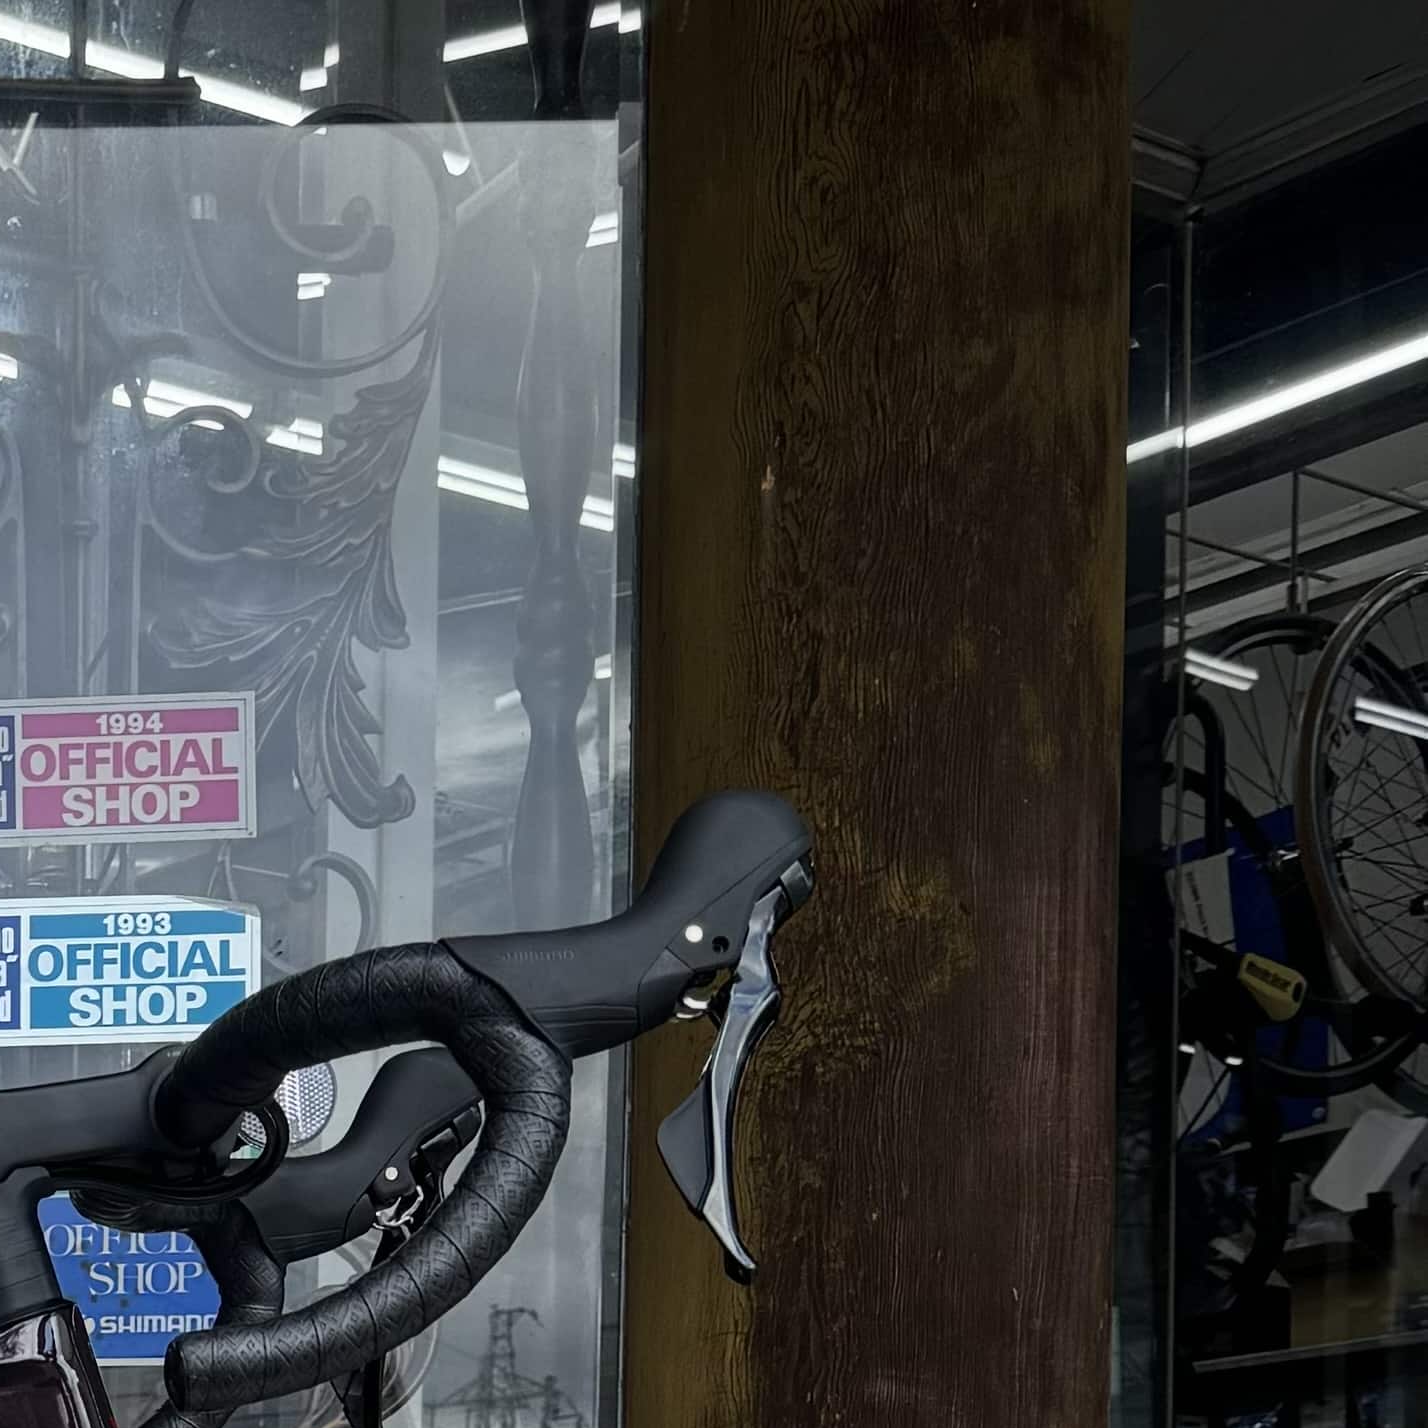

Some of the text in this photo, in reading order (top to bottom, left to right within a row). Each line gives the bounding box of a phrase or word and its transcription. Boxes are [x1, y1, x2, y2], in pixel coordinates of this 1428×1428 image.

[96, 712, 164, 735] 1994
[20, 737, 239, 783] OFFICIAL
[62, 783, 200, 827] SHOP
[102, 913, 172, 936] 1993
[27, 939, 247, 983] OFFICIAL
[69, 984, 208, 1028] SHOP
[89, 1260, 203, 1295] SHOP
